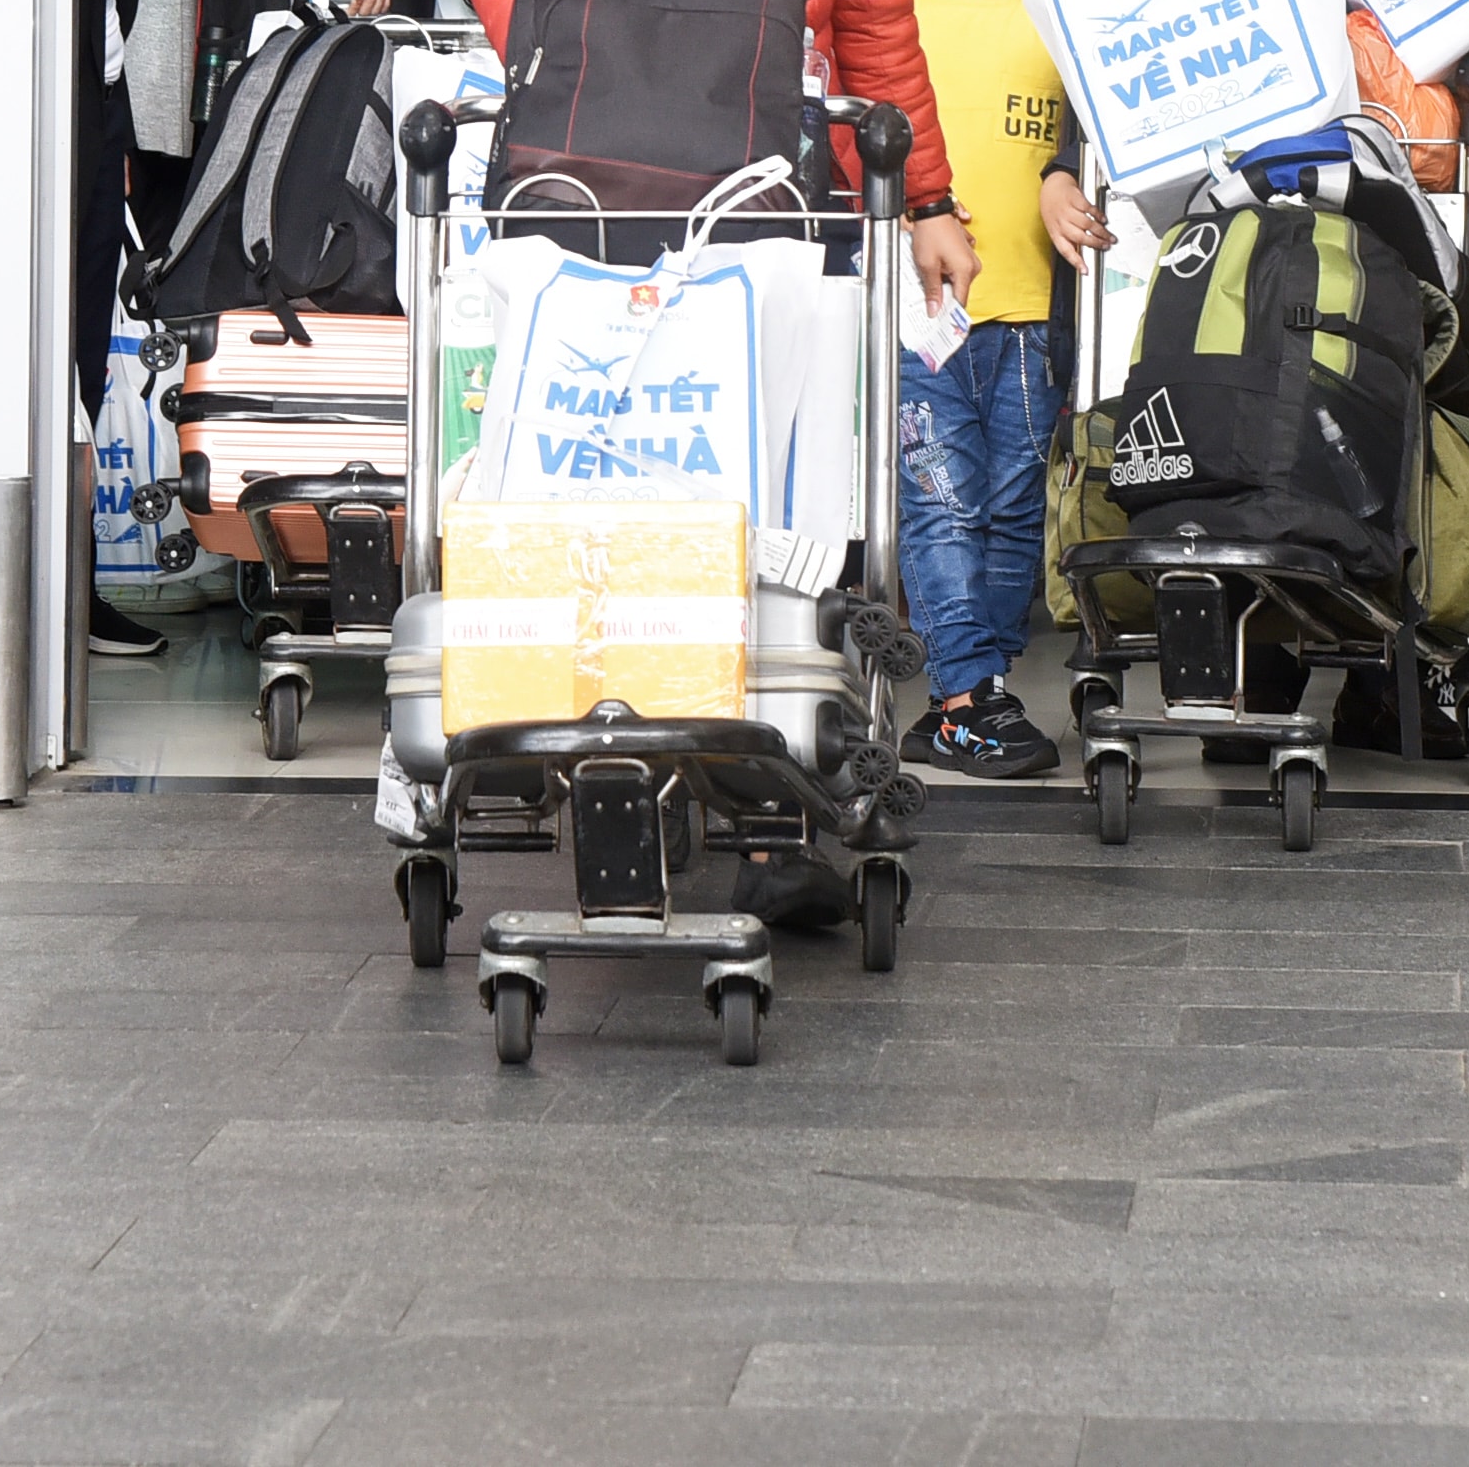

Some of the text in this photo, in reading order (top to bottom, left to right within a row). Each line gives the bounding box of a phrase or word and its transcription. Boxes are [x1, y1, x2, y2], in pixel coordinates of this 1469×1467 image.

[1097, 14, 1197, 68] MANG
[1108, 20, 1283, 111] VỀ NHÀ
[1006, 93, 1060, 120] FUT
[1159, 78, 1244, 131] 2022
[1004, 116, 1055, 143] URE
[459, 223, 491, 256] V
[642, 370, 721, 413] TẾT
[1109, 447, 1194, 487] adidas
